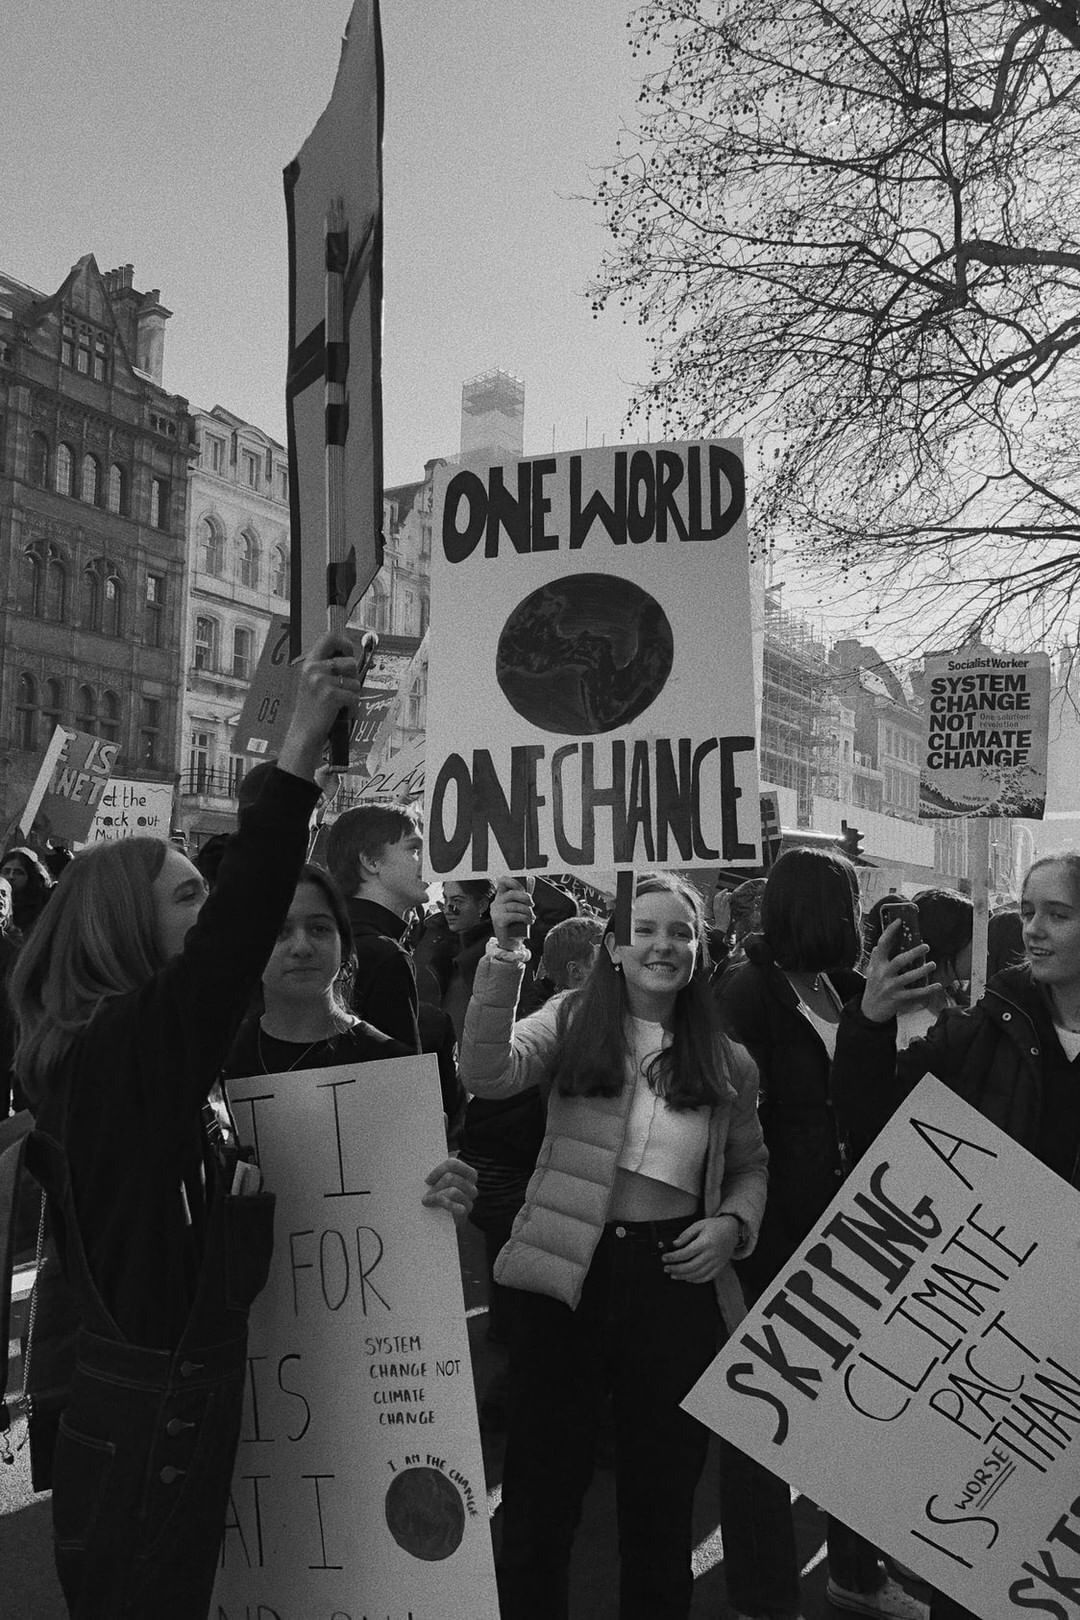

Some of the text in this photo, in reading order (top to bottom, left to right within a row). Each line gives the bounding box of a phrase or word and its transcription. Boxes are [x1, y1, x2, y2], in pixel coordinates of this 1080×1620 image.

[442, 445, 745, 564] ONE WORLD
[930, 674, 1026, 695] SYSTEM
[947, 657, 1029, 671] Socialist Worker
[929, 712, 976, 732] NOT
[930, 692, 1031, 713] CHANGE
[84, 740, 117, 774] IS
[926, 749, 1029, 769] CHANGE
[928, 730, 1032, 751] CLIMATE
[123, 786, 147, 808] the
[429, 736, 756, 873] ONE CHANCE
[316, 1079, 371, 1198] I
[289, 1225, 391, 1317] FOR
[726, 1117, 999, 1446] SKIPPING A
[843, 1203, 1039, 1422] CLIMATE
[364, 1335, 421, 1356] SYSTEM
[369, 1359, 461, 1379] CHANGE NOT
[241, 1353, 311, 1442] IS
[373, 1388, 425, 1404] CLIMATE
[928, 1311, 1041, 1440] PACT
[379, 1410, 436, 1425] CHANGE
[387, 1454, 478, 1518] I AM THE CHANGE
[954, 1446, 1010, 1511] WORSE
[301, 1474, 343, 1570] I
[910, 1494, 1000, 1569] IS
